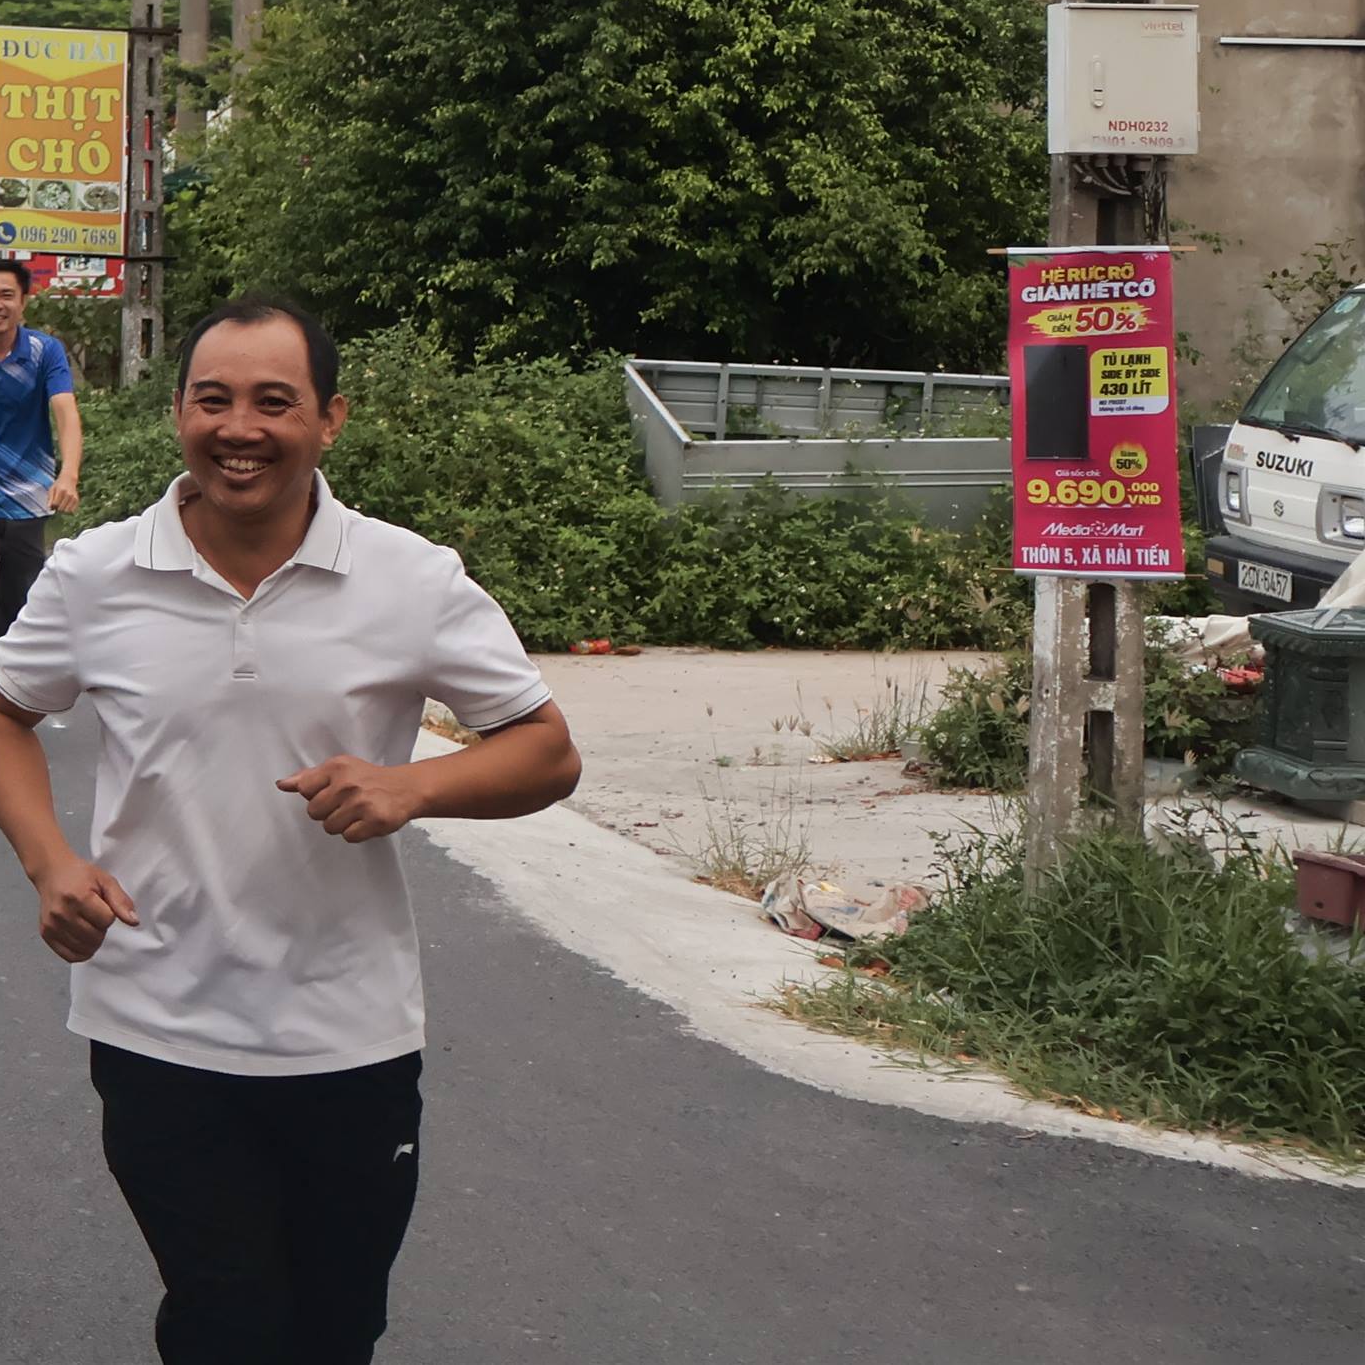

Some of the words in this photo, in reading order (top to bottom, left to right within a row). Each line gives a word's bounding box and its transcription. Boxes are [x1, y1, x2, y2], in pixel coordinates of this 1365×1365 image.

[0, 84, 120, 131] THỊT
[1108, 120, 1169, 132] NDH0232
[8, 130, 112, 175] CHÓ
[51, 227, 77, 244] 290
[82, 228, 117, 246] 7689
[1021, 282, 1080, 303] GIẢM
[1082, 279, 1124, 299] HẾT
[1123, 277, 1156, 297] CỠ
[1102, 351, 1117, 366] TỦ
[1120, 354, 1151, 367] LẠNH
[1101, 369, 1122, 379] SIDE
[1140, 368, 1161, 378] SIDE
[1099, 383, 1128, 395] 430
[1132, 379, 1152, 395] LÍT
[1116, 458, 1142, 470] 50%
[1255, 450, 1314, 477] SUZUKI
[1026, 478, 1126, 505] 9.690
[1041, 522, 1091, 537] Media
[1105, 523, 1145, 537] Mart
[1021, 543, 1061, 564] THÔN
[1064, 548, 1078, 566] 5,
[1081, 544, 1102, 565] XÃ
[1105, 542, 1131, 566] HẢI
[1135, 543, 1170, 566] TIẾN
